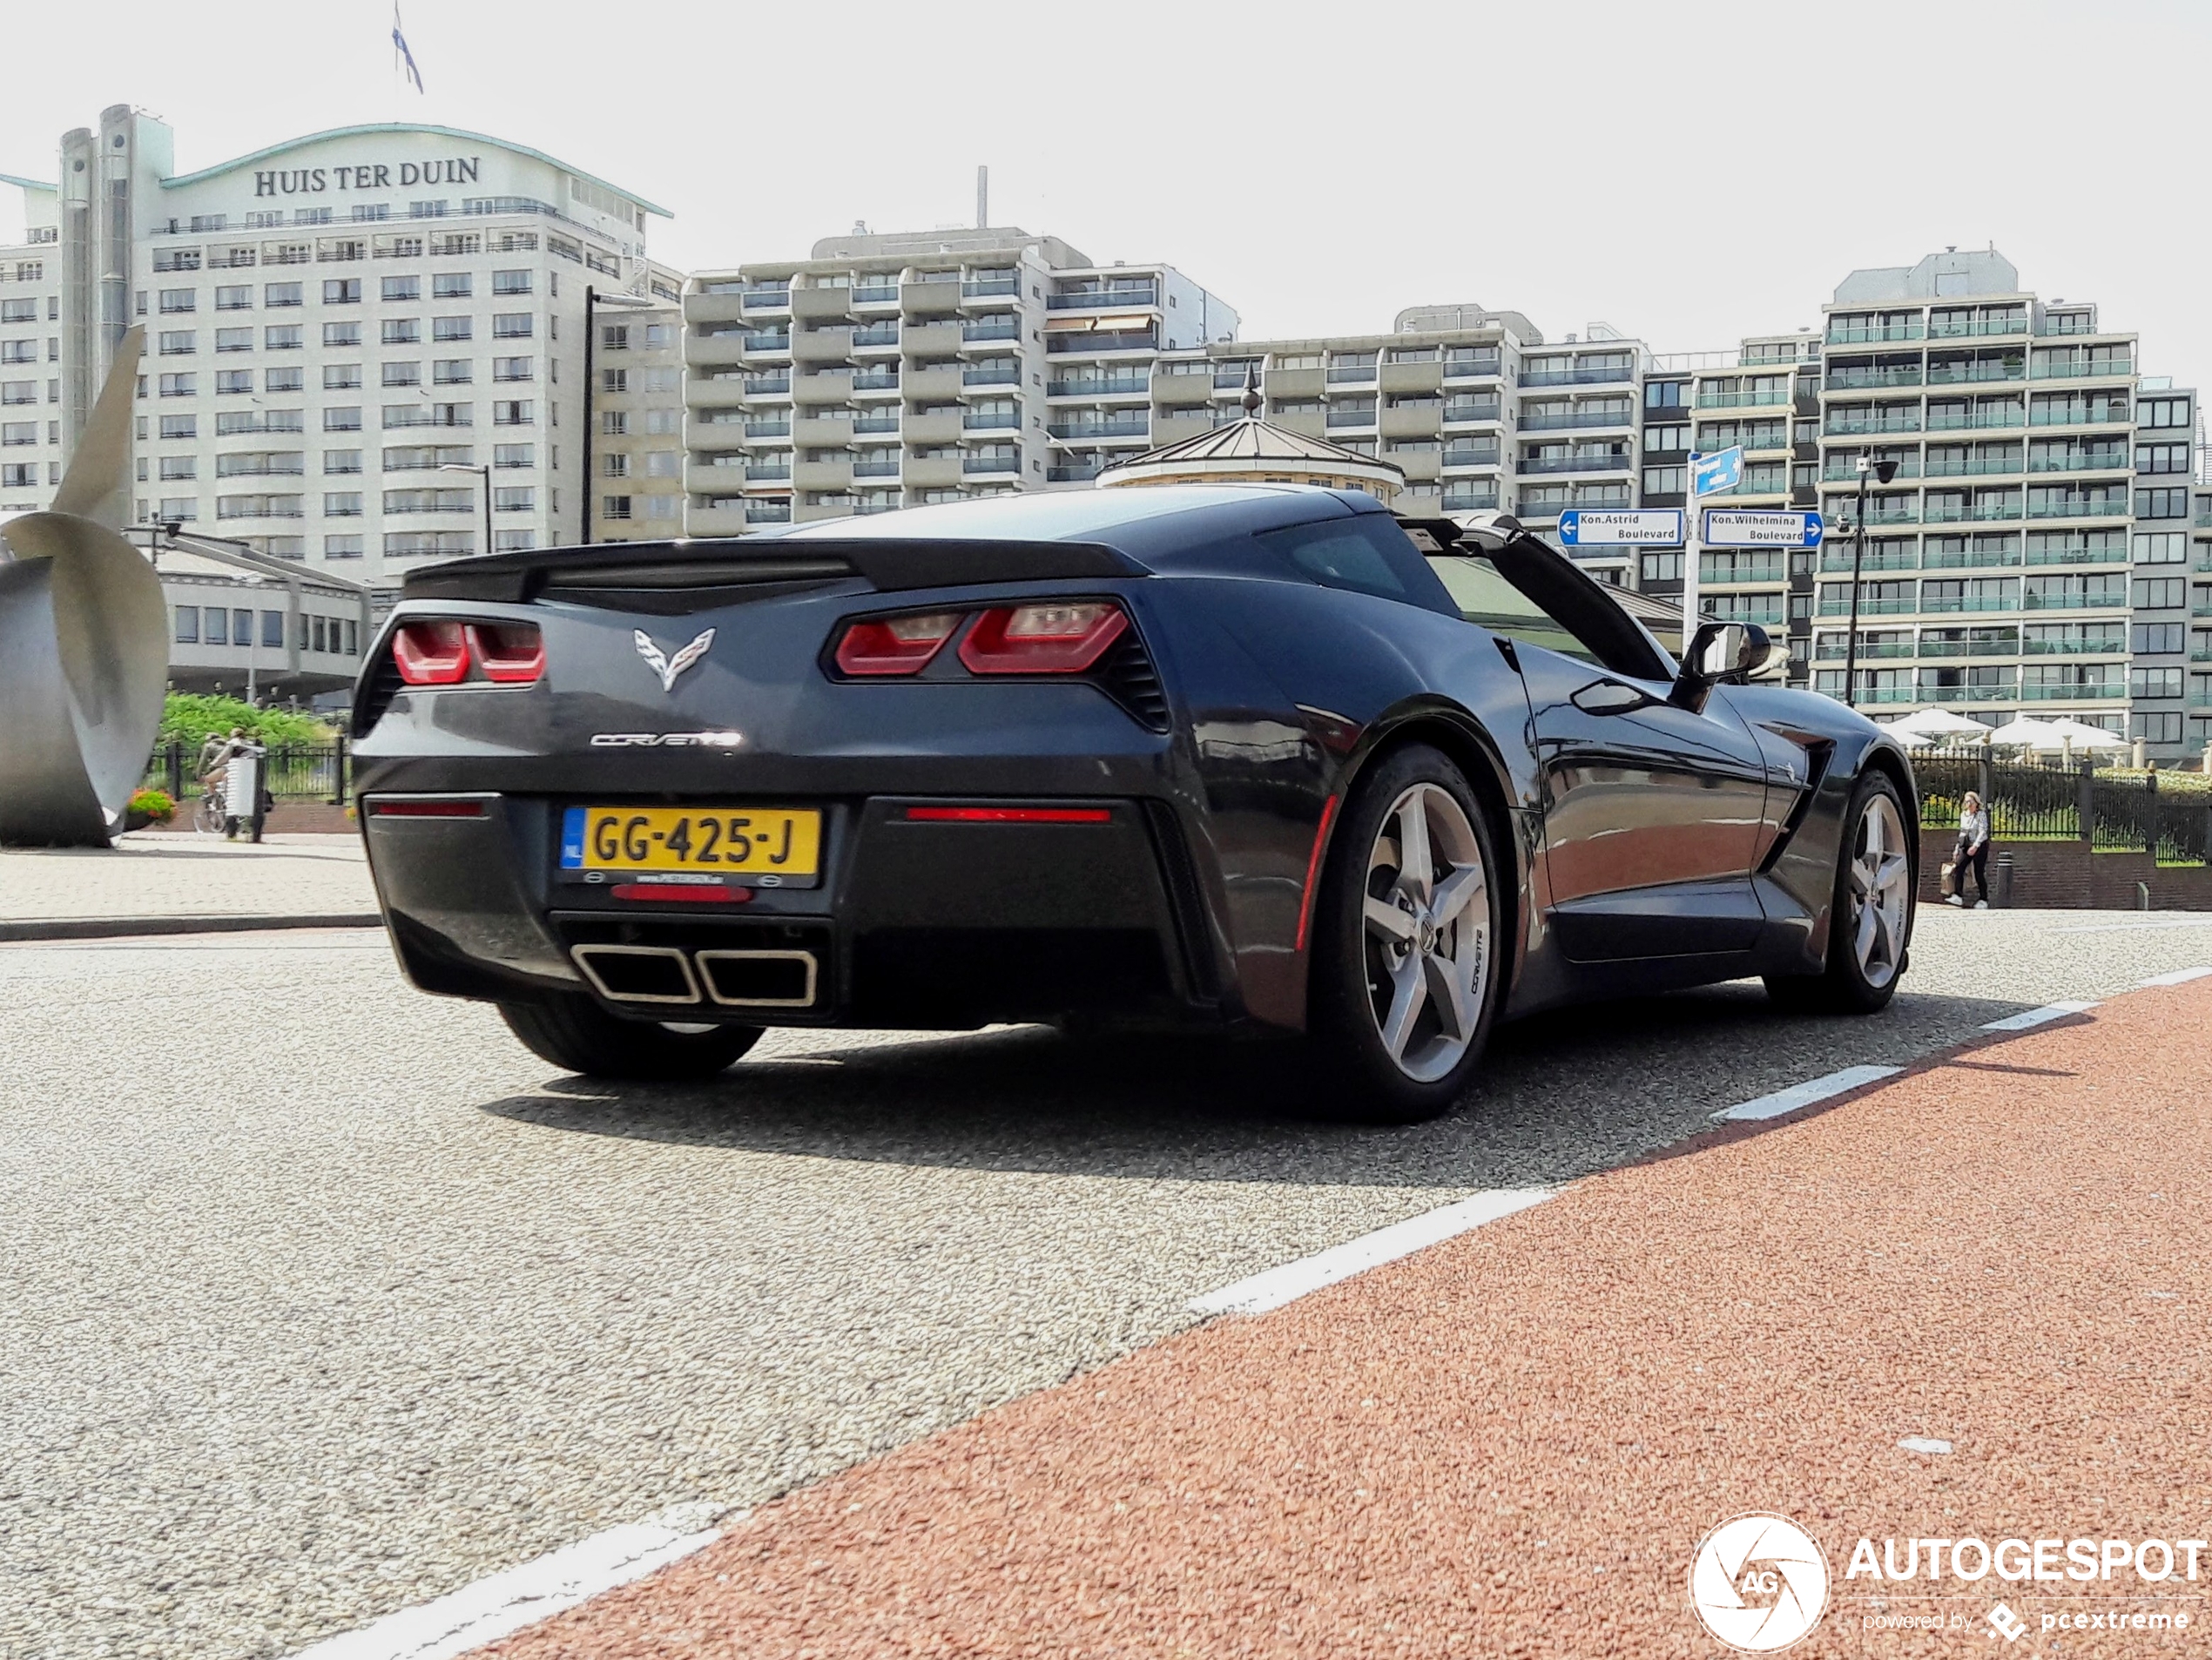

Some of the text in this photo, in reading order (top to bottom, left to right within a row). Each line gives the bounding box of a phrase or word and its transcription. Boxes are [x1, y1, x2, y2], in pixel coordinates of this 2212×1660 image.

[253, 157, 481, 197] HUIS TER DUIN
[1580, 514, 1639, 524] Kon.Astrid
[1711, 514, 1796, 526] Kon.Wilhelmina
[1618, 529, 1675, 539] Boulevard
[1750, 530, 1804, 541] Boulevard
[590, 732, 745, 746] CORVET
[594, 815, 793, 864] GG-425-J
[1471, 928, 1483, 995] CORVETTE
